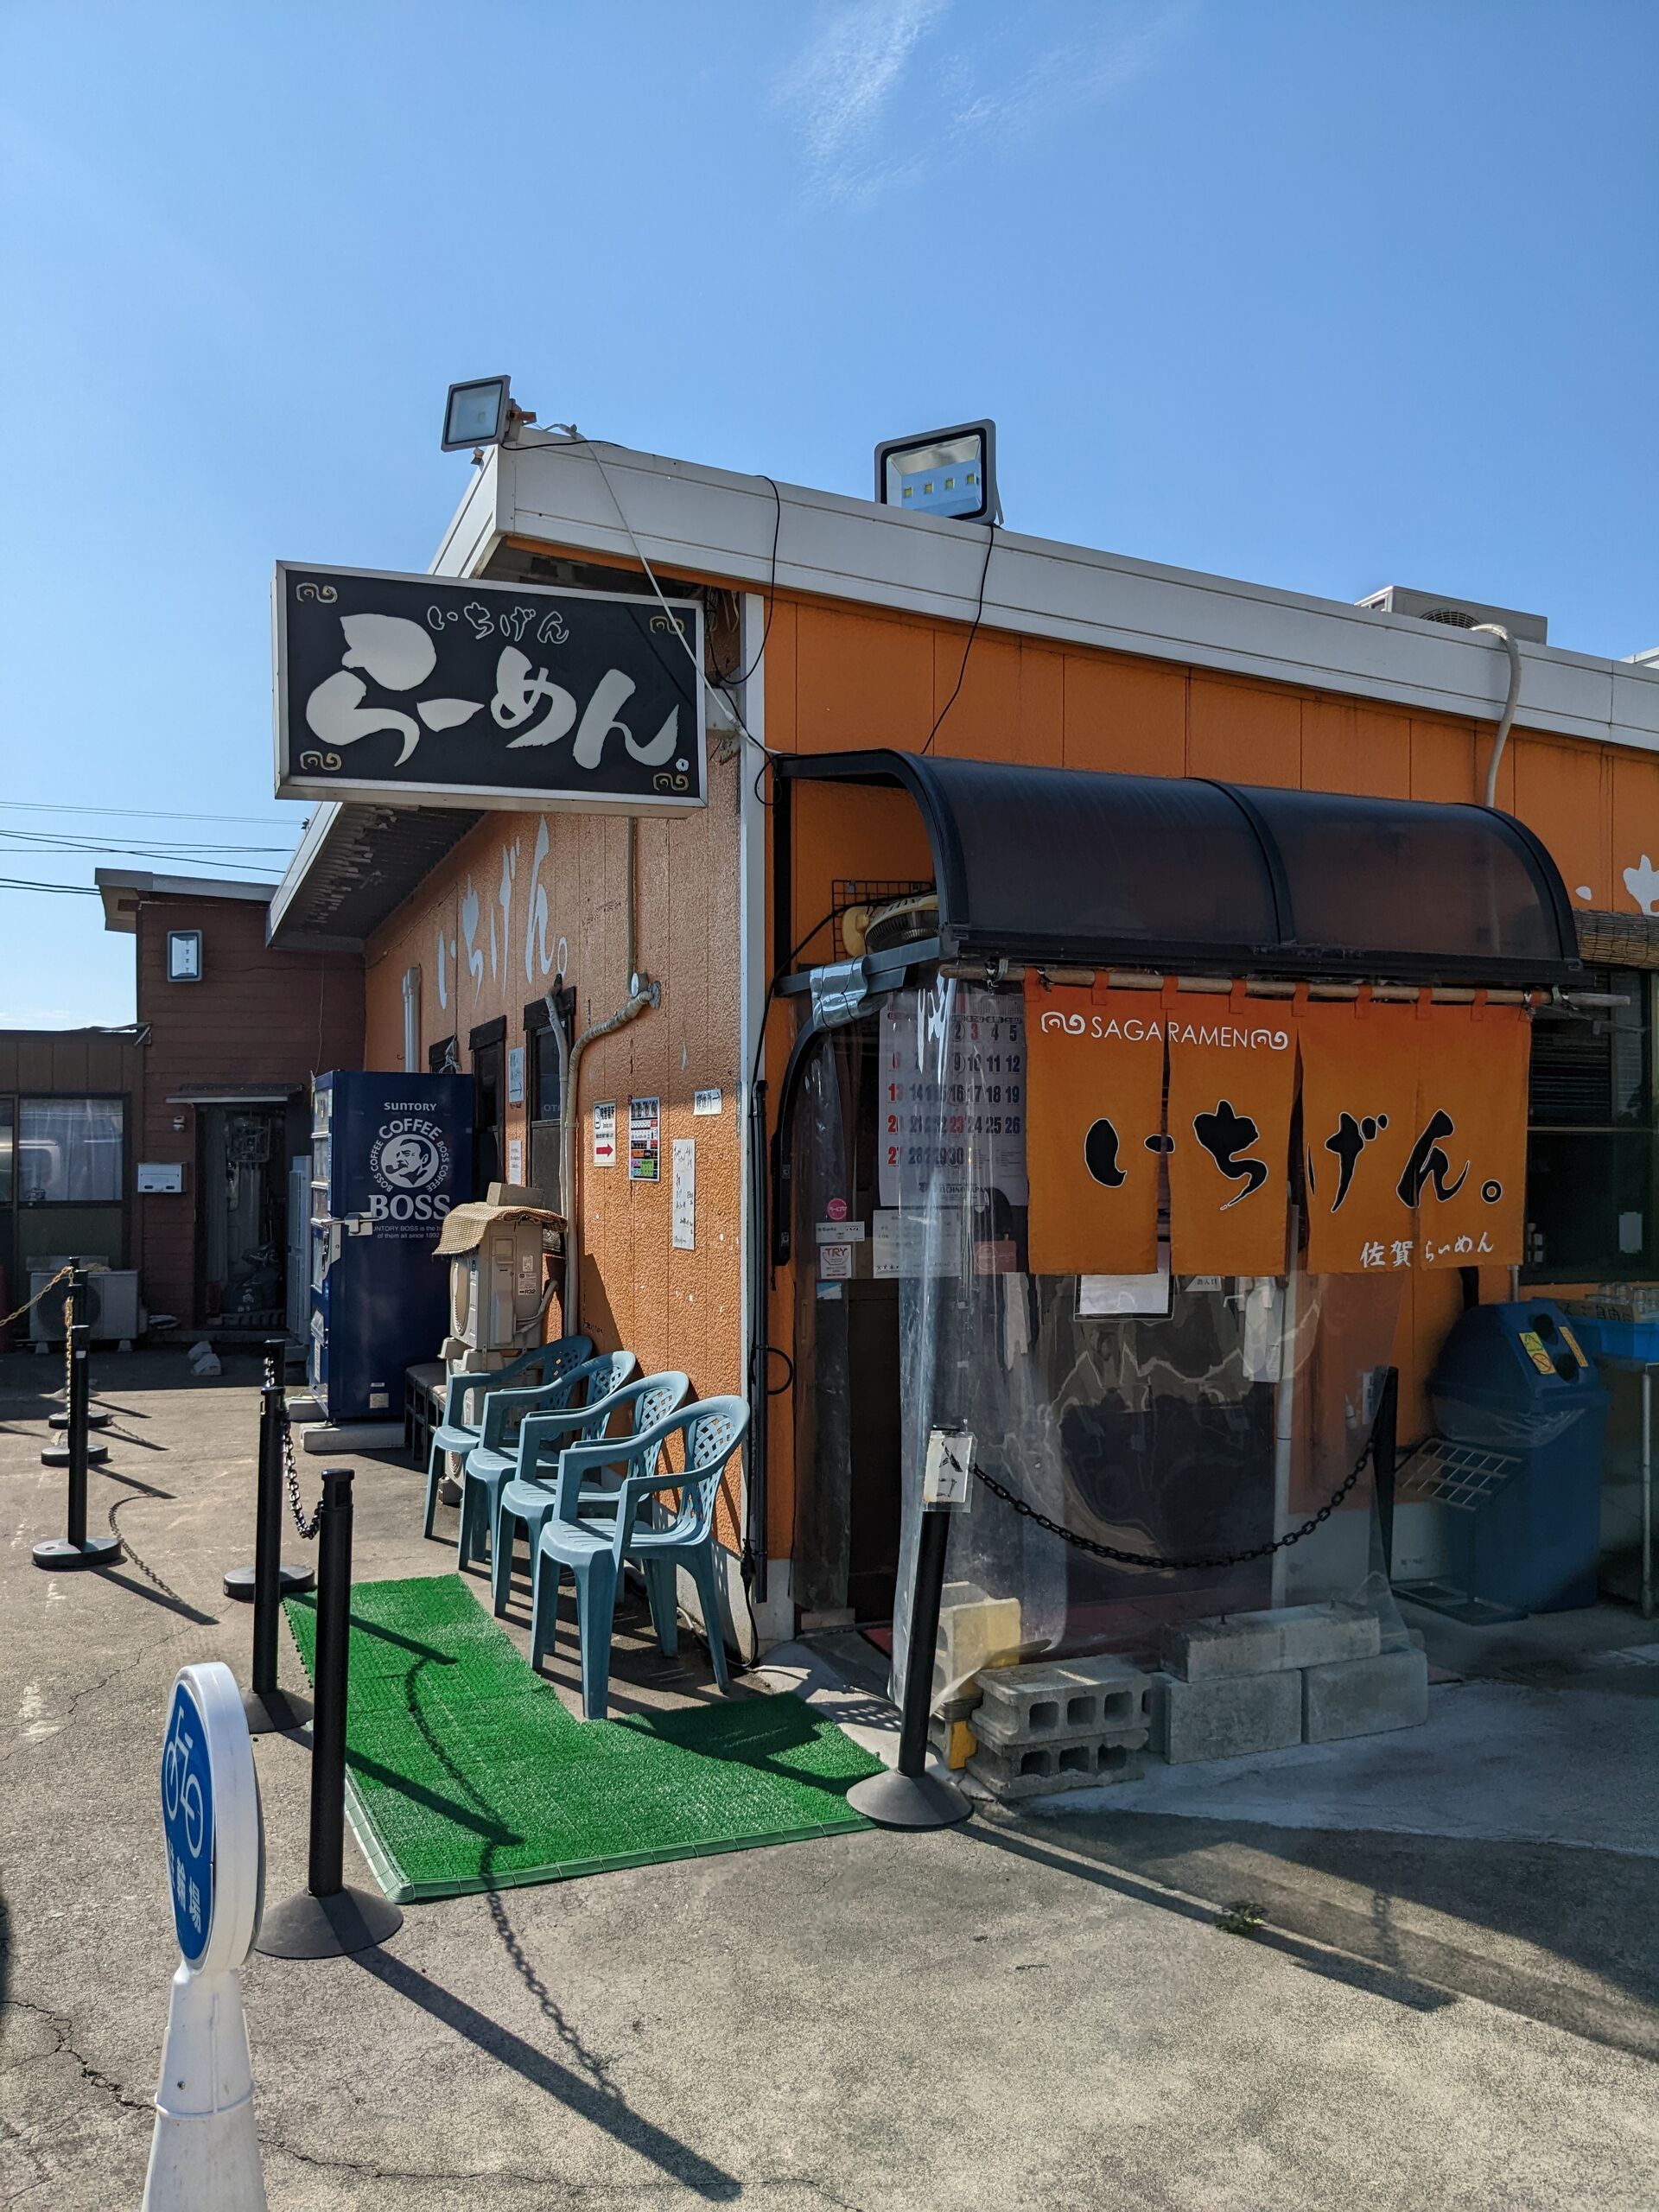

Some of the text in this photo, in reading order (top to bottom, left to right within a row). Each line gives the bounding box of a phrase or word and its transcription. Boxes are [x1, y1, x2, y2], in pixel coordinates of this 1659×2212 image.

[427, 601, 569, 645] いちげん
[954, 1021, 1017, 1042] 2 3 4 5
[954, 1052, 1020, 1072] 9 10 11 12
[950, 1084, 964, 1103] 16
[968, 1085, 982, 1103] 17
[986, 1085, 1001, 1103] 18
[1005, 1085, 1020, 1103] 19
[384, 1102, 437, 1111] SUNTORY
[378, 1117, 443, 1141] COFFEE
[950, 1116, 964, 1134] 23
[986, 1116, 1001, 1135] 25
[1005, 1116, 1020, 1135] 26
[370, 1140, 394, 1192] BOSS COFFEE
[425, 1141, 449, 1192] BOSS COFFEE
[950, 1147, 964, 1165] 30
[368, 1194, 450, 1221] BOSS
[824, 1247, 848, 1257] TRY
[1360, 1240, 1412, 1268] 佐賀
